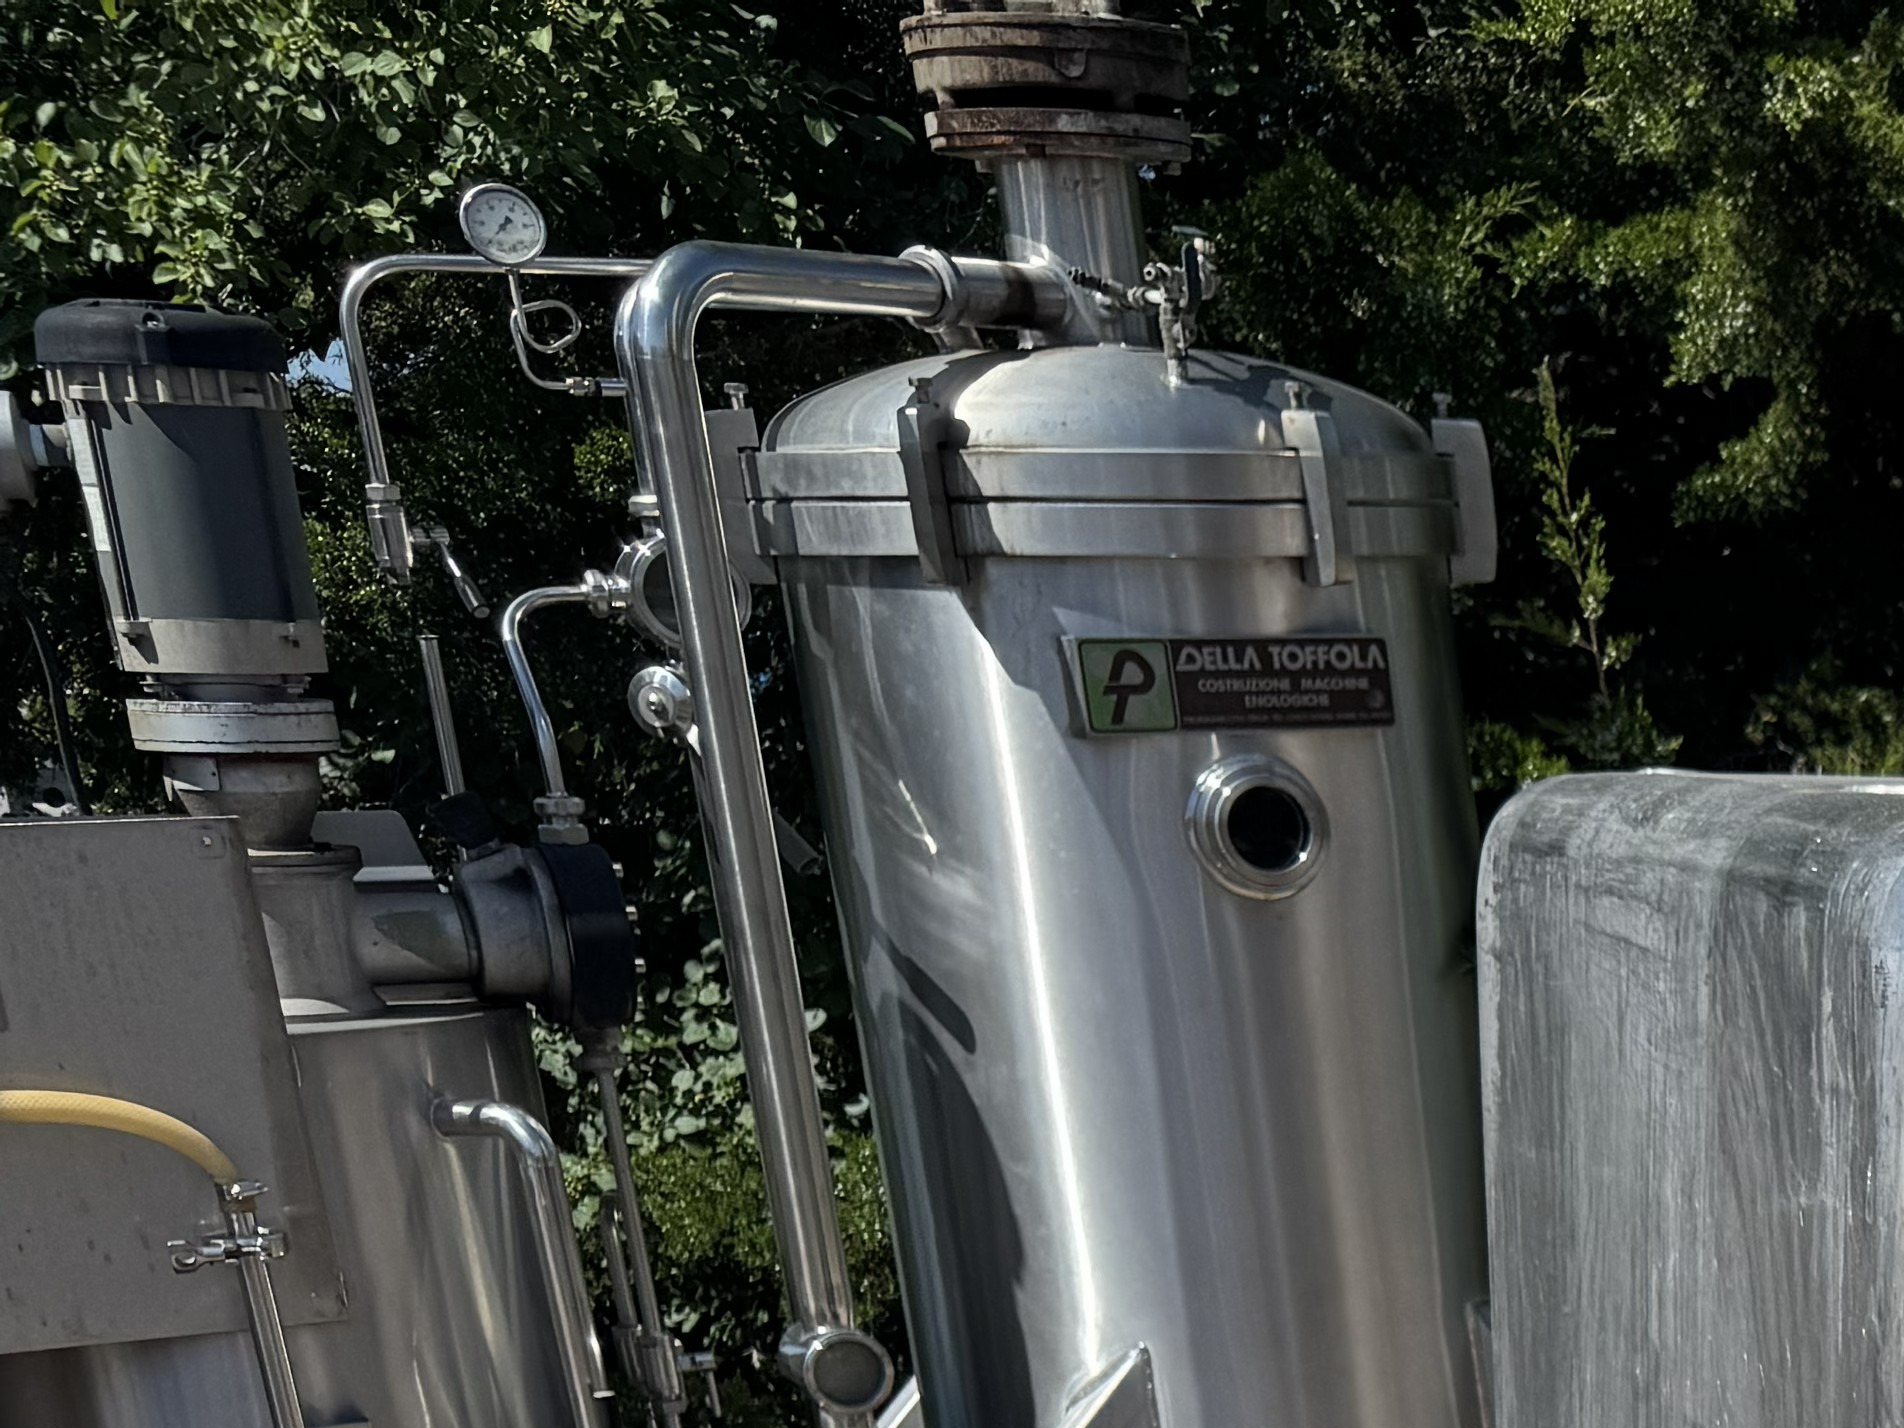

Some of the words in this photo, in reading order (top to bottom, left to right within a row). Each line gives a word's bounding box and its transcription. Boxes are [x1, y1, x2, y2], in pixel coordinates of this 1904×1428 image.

[1175, 645, 1262, 672] DELLA
[1268, 643, 1386, 671] TOFFOLA
[1197, 677, 1291, 693] COSTRUZIONE
[1300, 676, 1369, 691] MACCHINE
